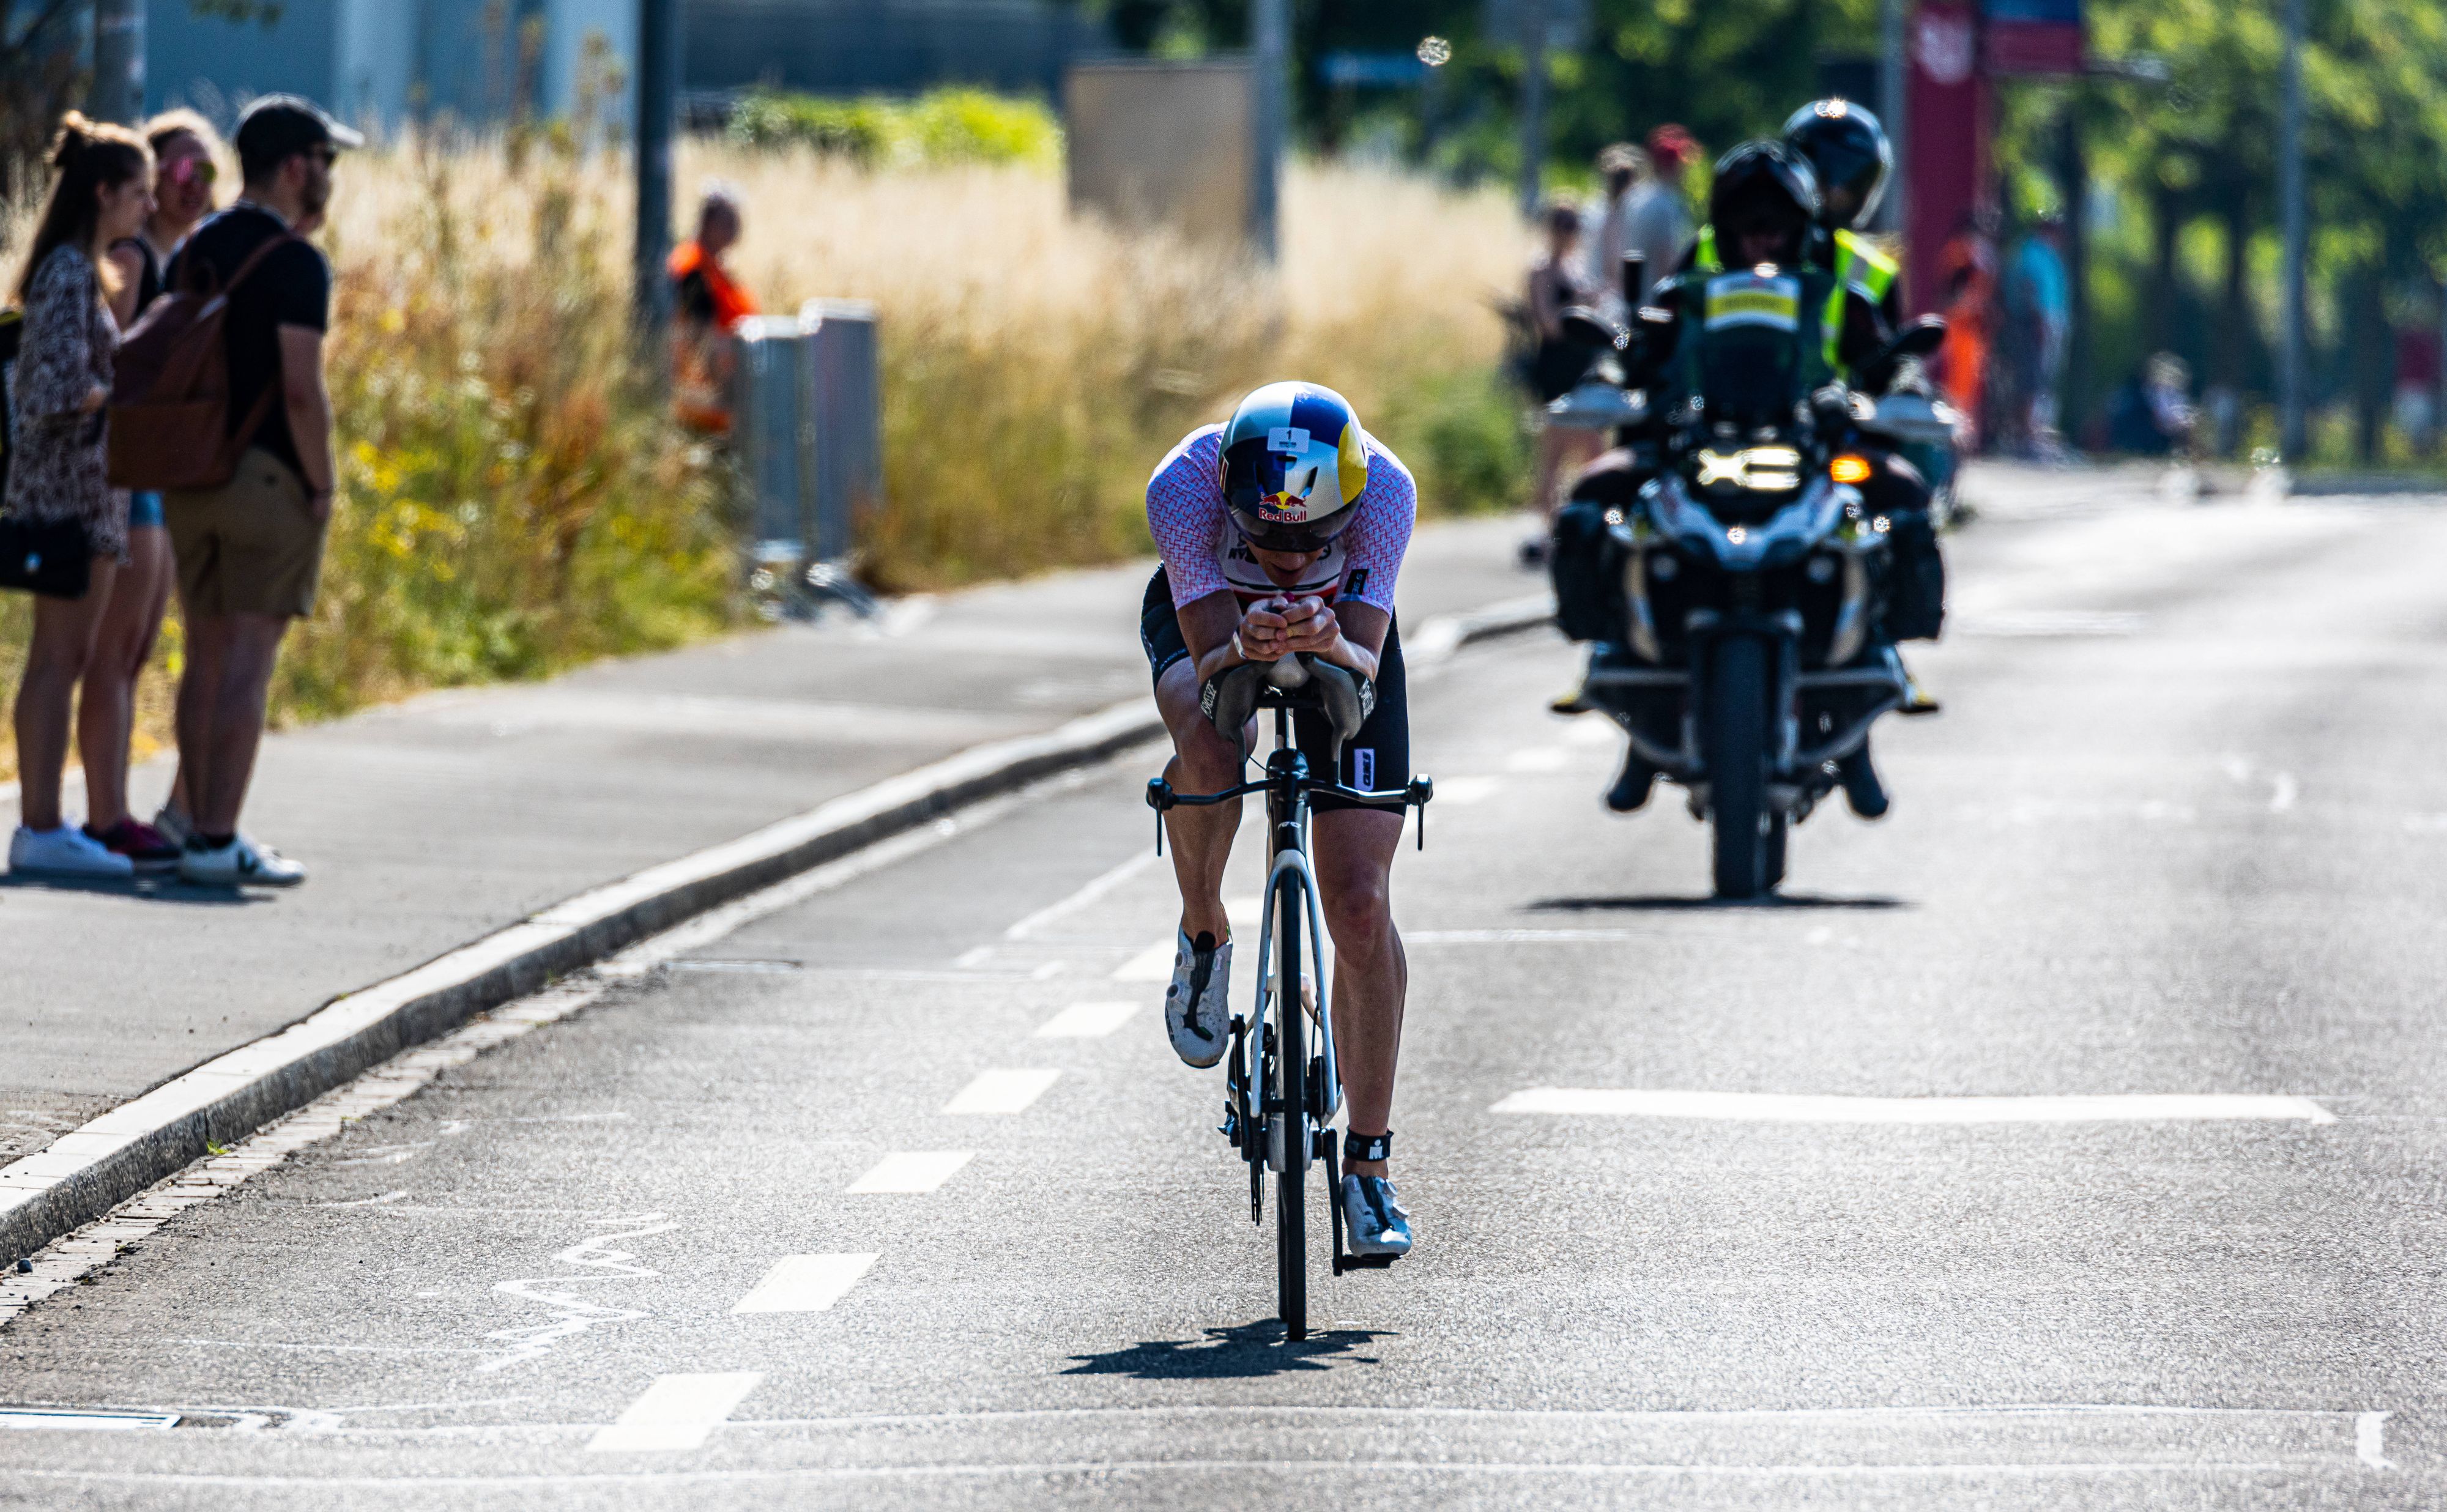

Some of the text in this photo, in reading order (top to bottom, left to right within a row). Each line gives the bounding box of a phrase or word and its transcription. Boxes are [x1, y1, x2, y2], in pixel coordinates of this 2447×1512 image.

[1286, 429, 1292, 440] 1
[1259, 507, 1307, 522] Red Bull
